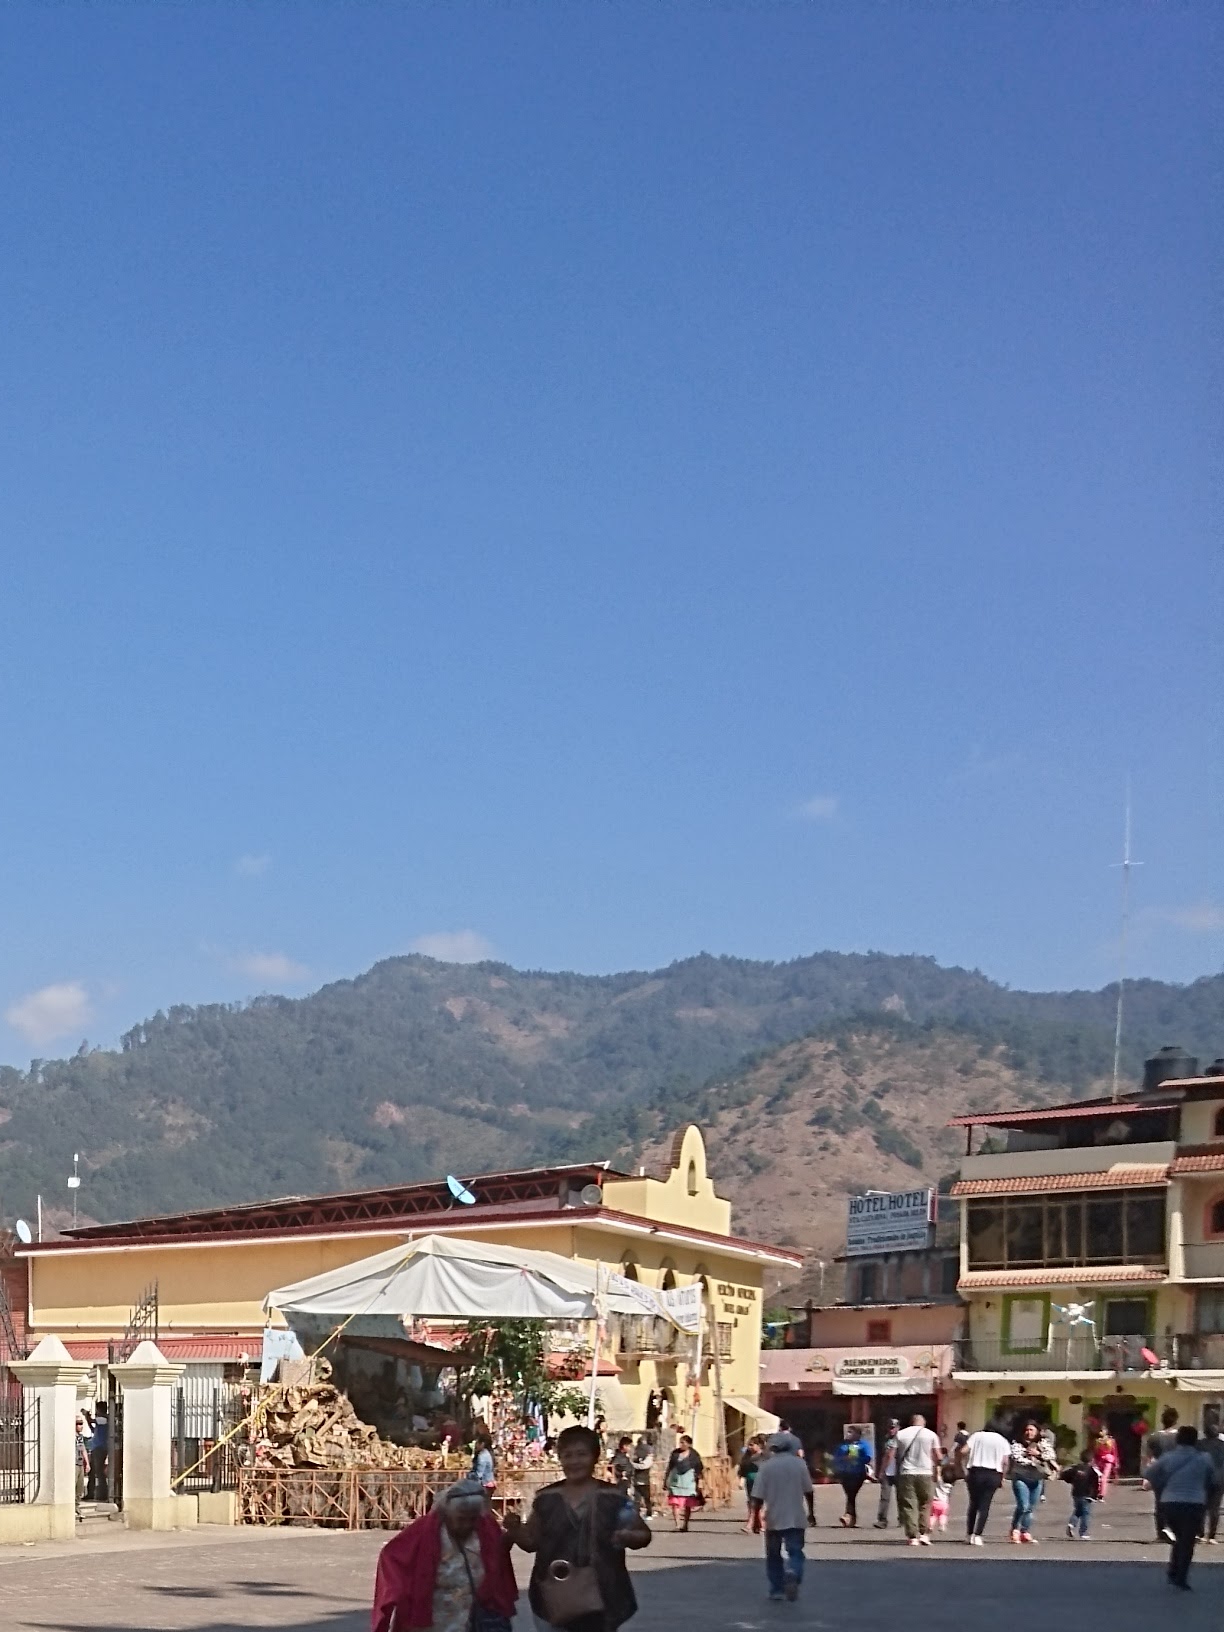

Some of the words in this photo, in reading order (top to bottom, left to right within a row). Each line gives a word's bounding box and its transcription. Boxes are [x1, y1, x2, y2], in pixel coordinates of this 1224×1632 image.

[849, 1197, 886, 1215] HOTEL
[888, 1191, 927, 1210] HOTEL
[843, 1357, 898, 1367] BIENVENIDOS
[839, 1367, 875, 1375] COMEDOR
